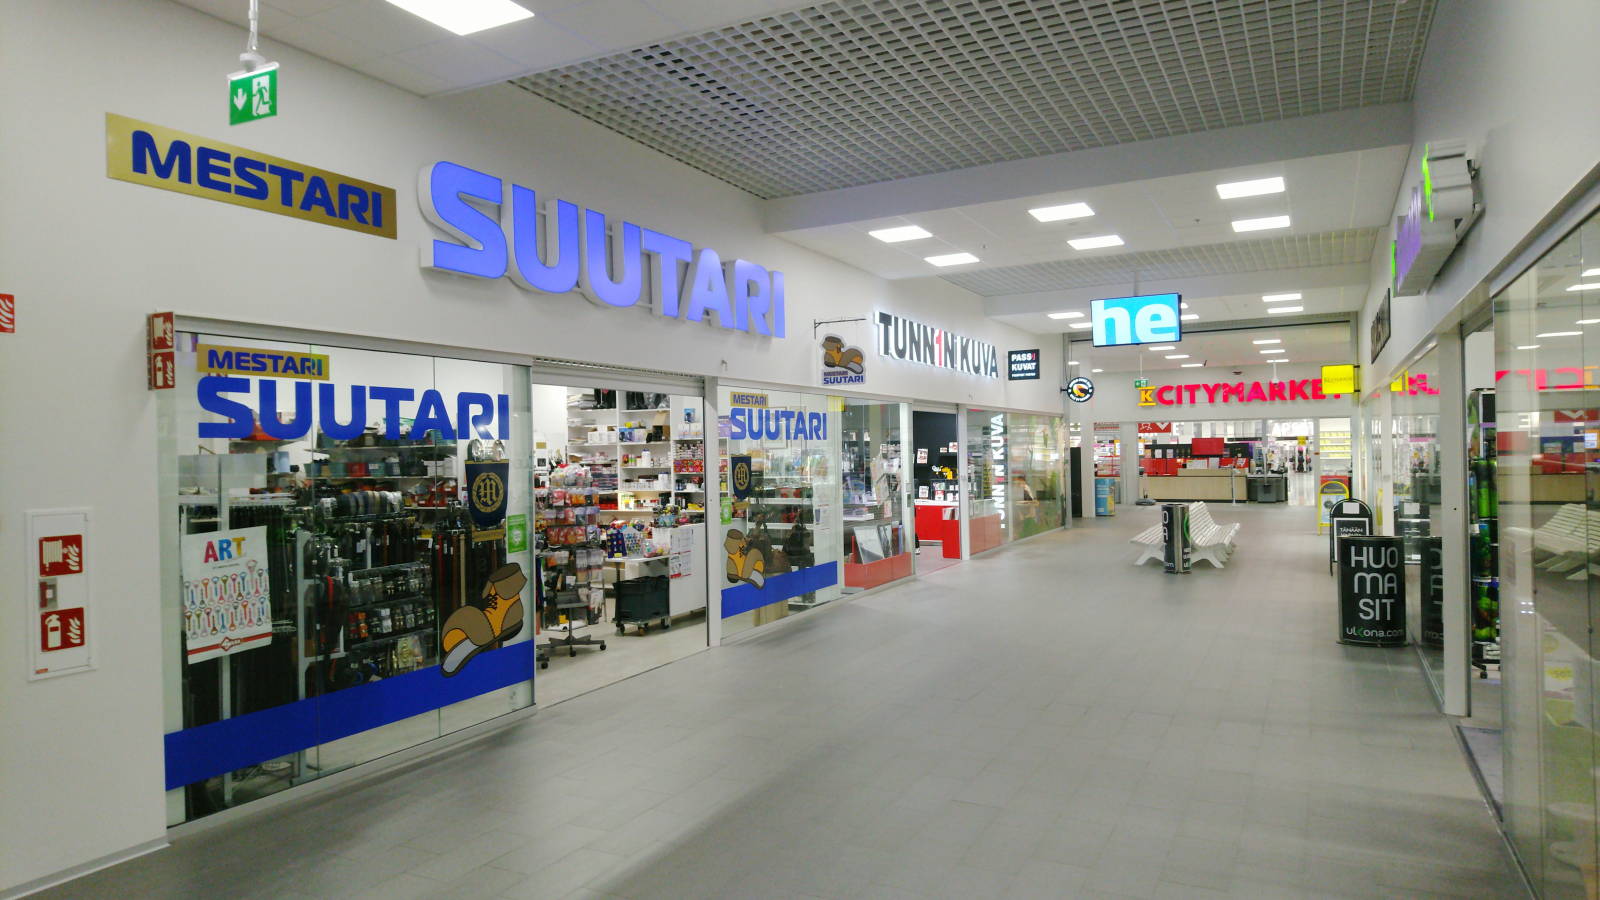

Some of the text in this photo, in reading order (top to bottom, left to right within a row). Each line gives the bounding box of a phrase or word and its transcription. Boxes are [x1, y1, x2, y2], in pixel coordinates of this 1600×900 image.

[131, 130, 383, 228] MESTARI
[426, 161, 785, 338] SUUTARI
[1091, 300, 1178, 345] he
[207, 348, 323, 376] MESTARI
[957, 335, 999, 378] KUVA
[1011, 363, 1036, 371] KUVAT
[823, 375, 864, 385] SUUTARI
[1156, 378, 1341, 405] CITYMARKE
[197, 375, 510, 441] SUUTARI
[733, 394, 767, 406] MESTARI
[730, 407, 828, 440] SUUTARI
[991, 413, 1005, 460] KUVA
[204, 536, 246, 563] ART
[1350, 546, 1399, 569] HUO
[1354, 572, 1398, 595] MA
[1358, 598, 1396, 621] SIT
